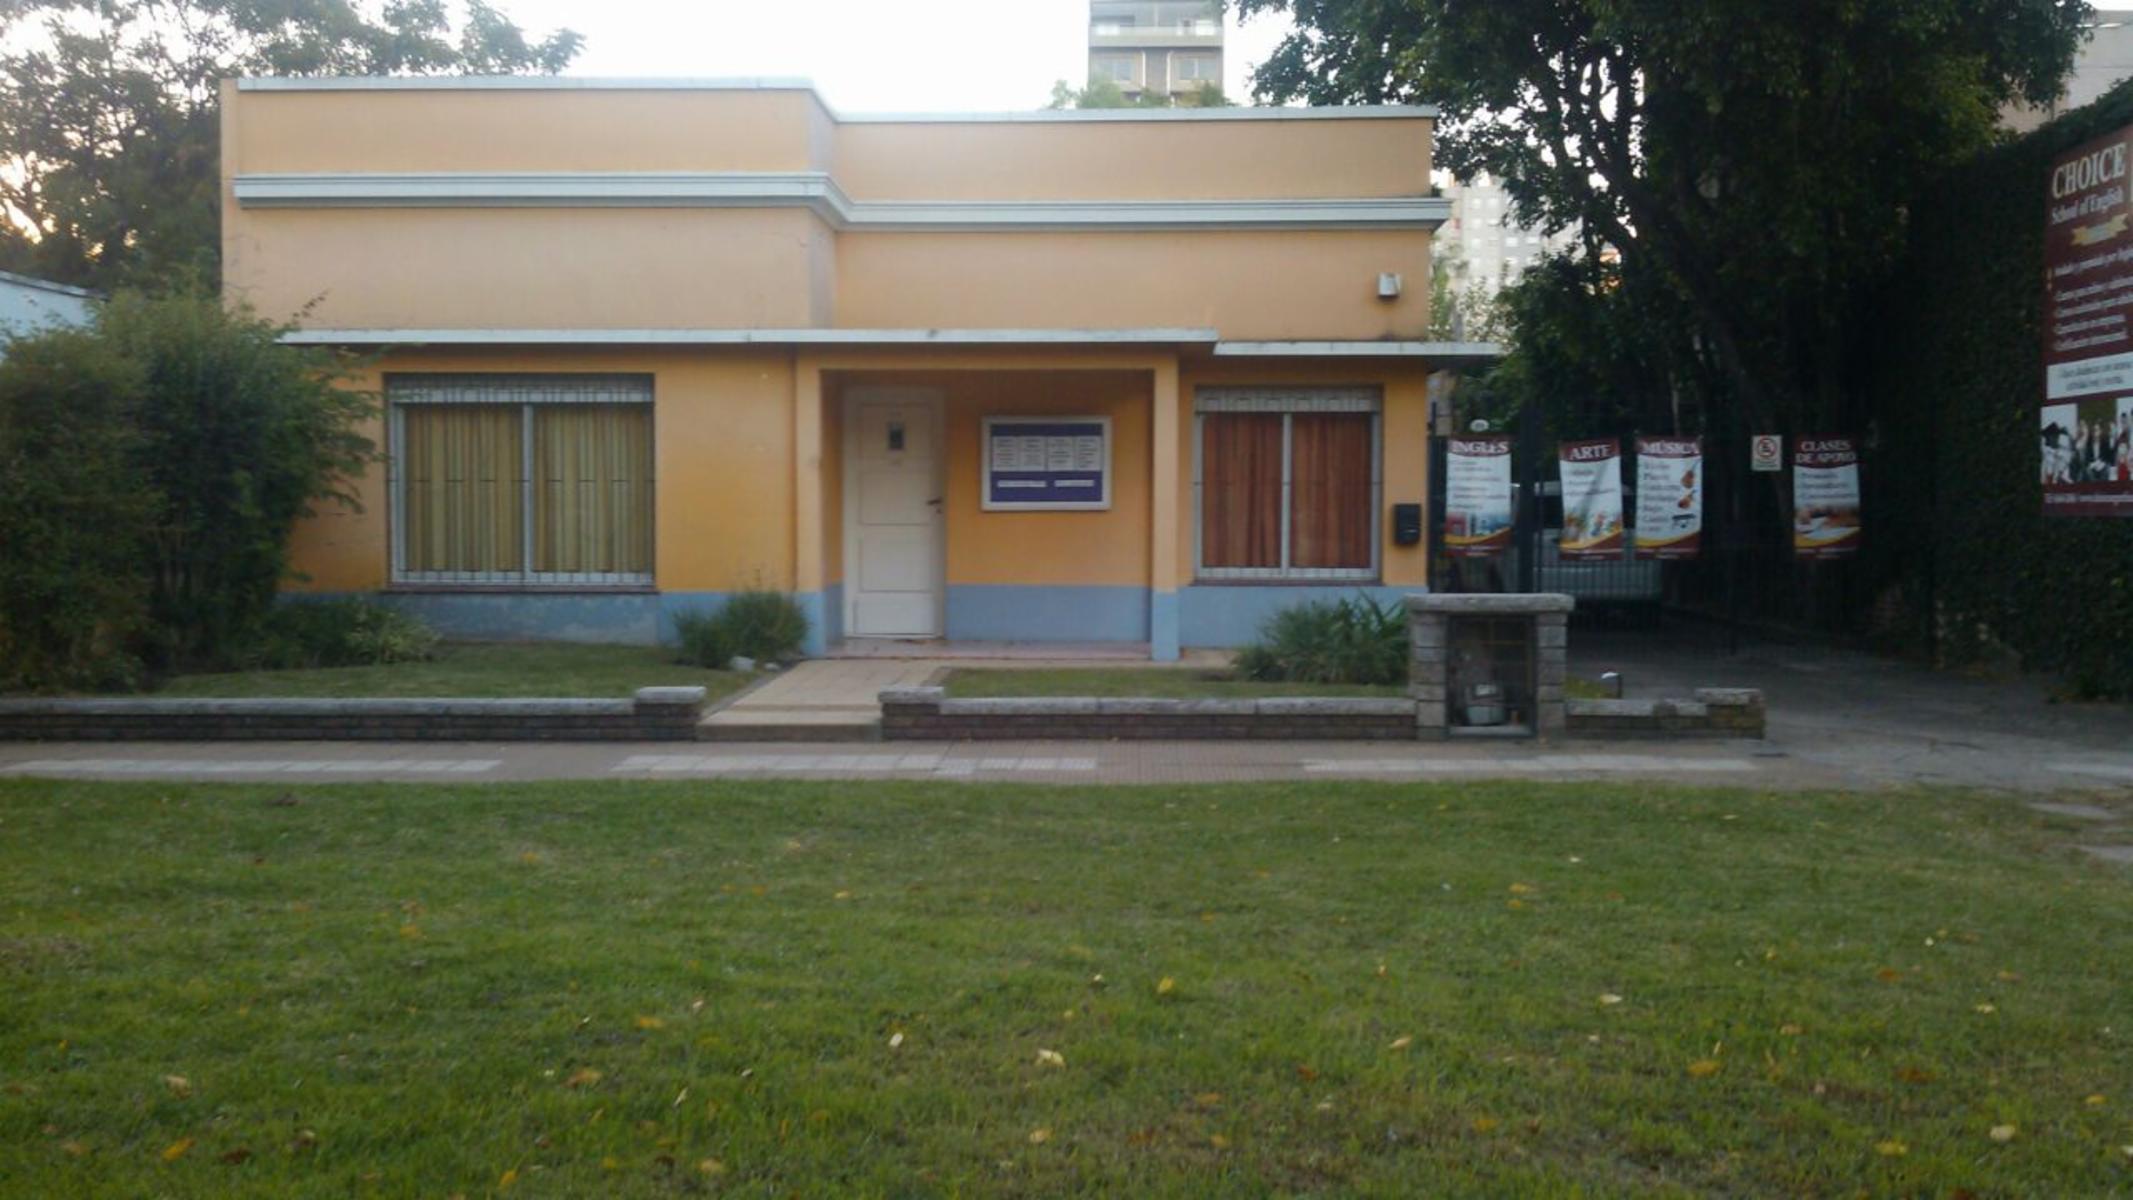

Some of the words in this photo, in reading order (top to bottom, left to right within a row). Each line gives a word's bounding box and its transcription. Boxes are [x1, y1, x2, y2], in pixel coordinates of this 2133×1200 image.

[2052, 142, 2127, 199] CHOICE
[2051, 200, 2078, 225] School
[2089, 185, 2123, 214] English
[1569, 444, 1611, 460] ARTE
[1801, 440, 1851, 453] CLASES
[1795, 453, 1814, 464] DE
